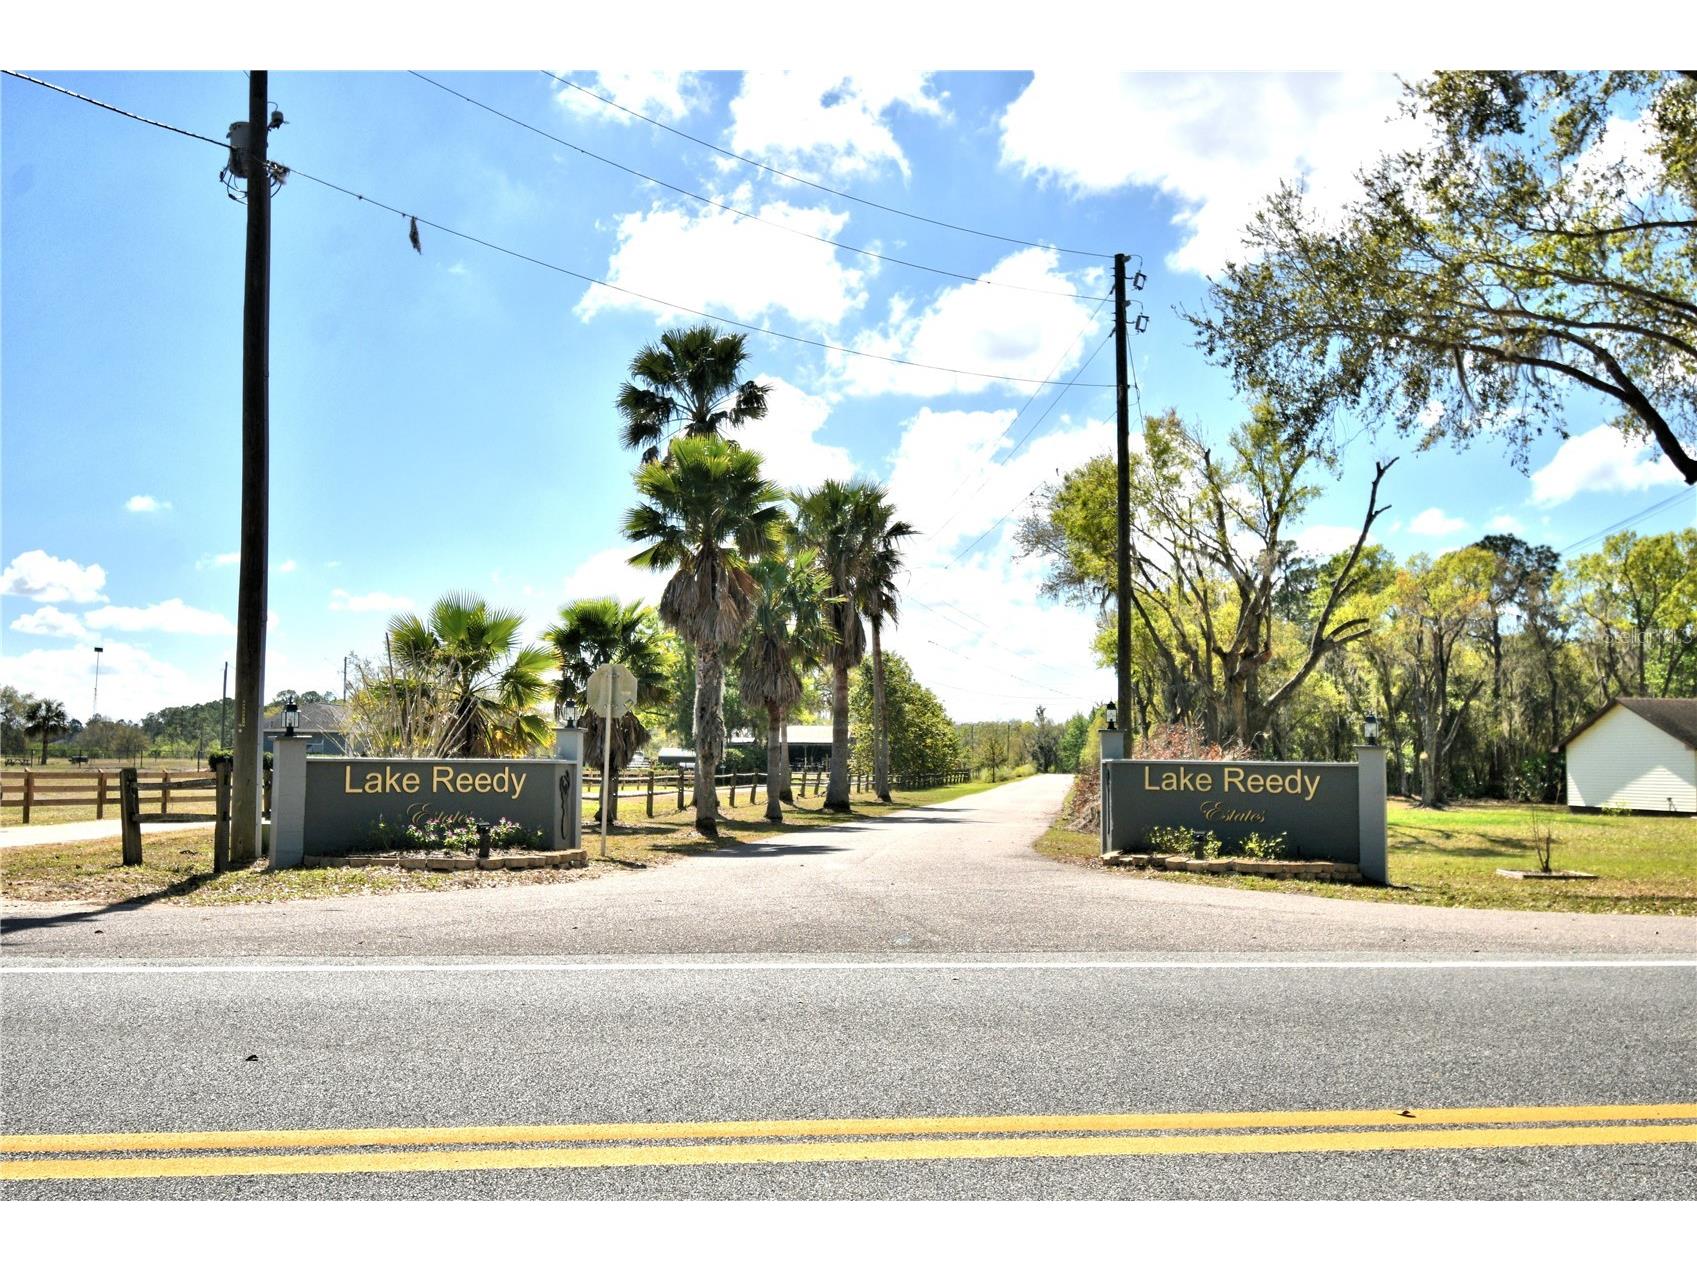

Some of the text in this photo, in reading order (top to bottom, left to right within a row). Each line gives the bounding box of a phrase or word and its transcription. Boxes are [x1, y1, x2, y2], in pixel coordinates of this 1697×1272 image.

[344, 765, 527, 800] Lake Reedy
[1143, 765, 1321, 801] Lake Reedy
[1200, 800, 1266, 823] Estates
